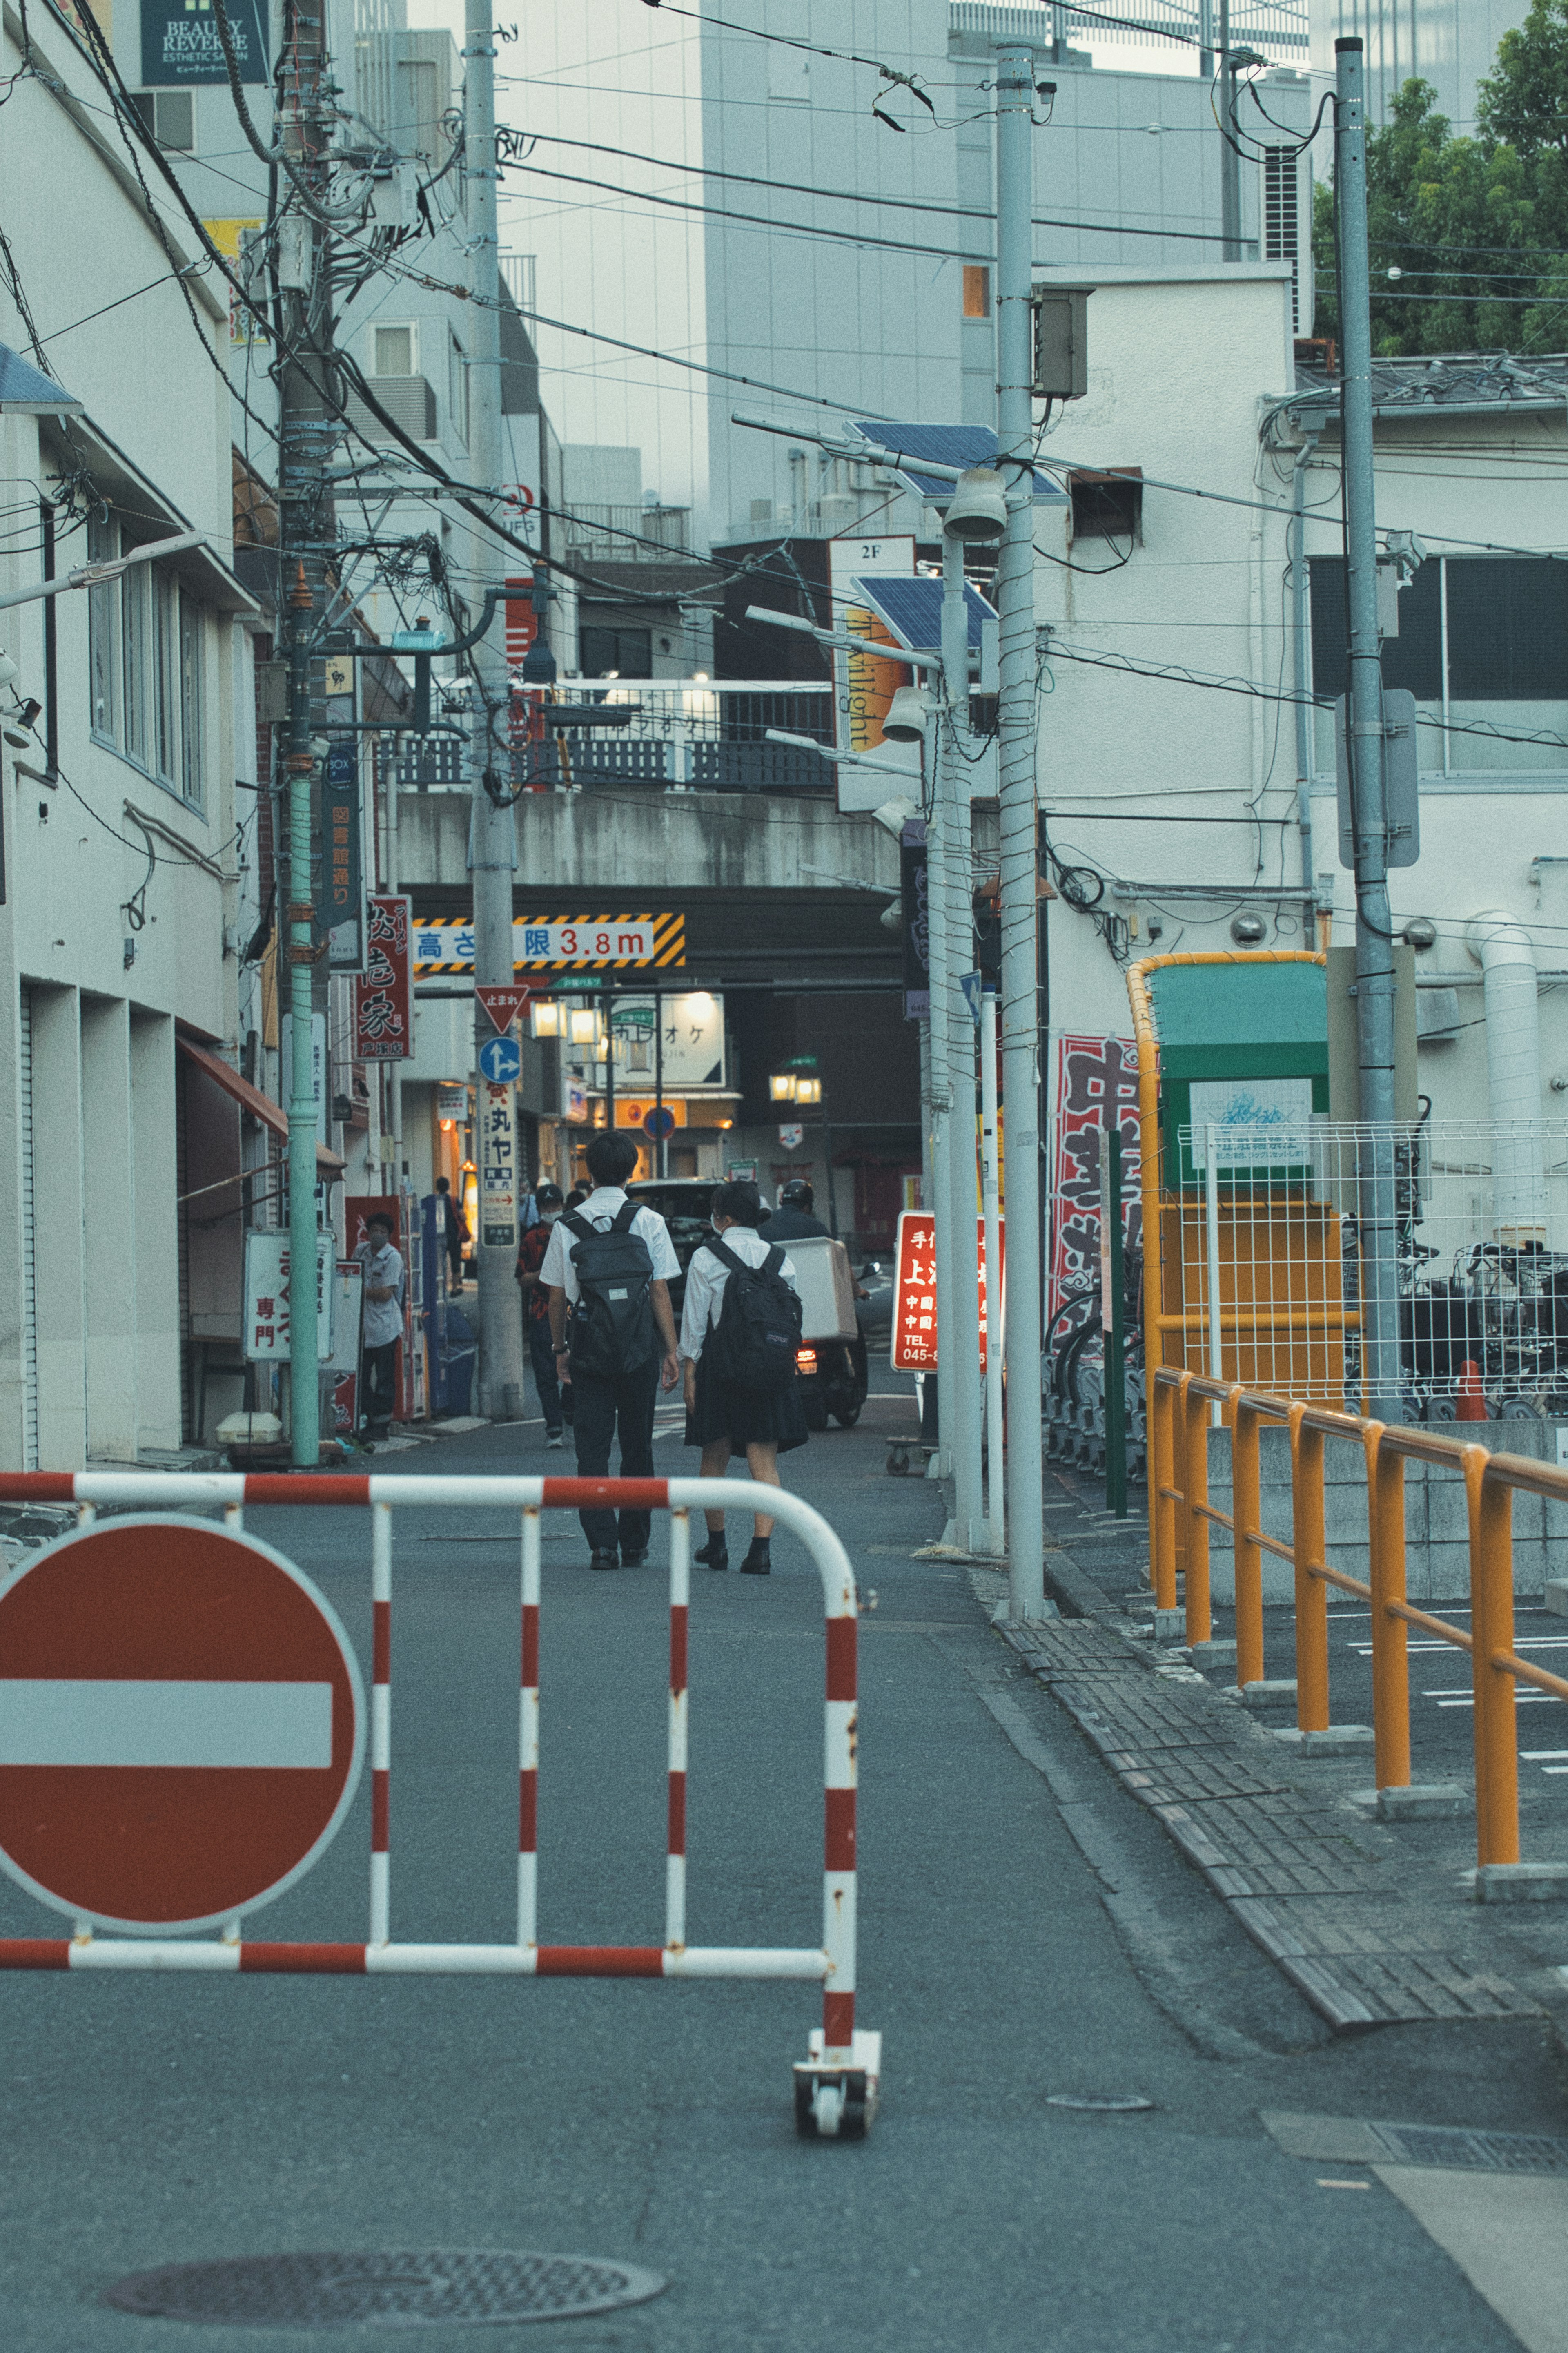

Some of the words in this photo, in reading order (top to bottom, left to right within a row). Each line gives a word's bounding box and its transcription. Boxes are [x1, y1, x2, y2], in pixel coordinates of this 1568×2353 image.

[167, 20, 243, 36] BEAUY
[163, 52, 210, 62] ESTHETIC
[862, 545, 881, 558] 2F
[332, 806, 349, 906] 図書館通り
[395, 905, 407, 954] ラーメン
[487, 995, 518, 1006] 止まれ
[362, 1042, 403, 1055] 戸塚店
[256, 1298, 275, 1347] 専門
[904, 1334, 929, 1347] TEL.
